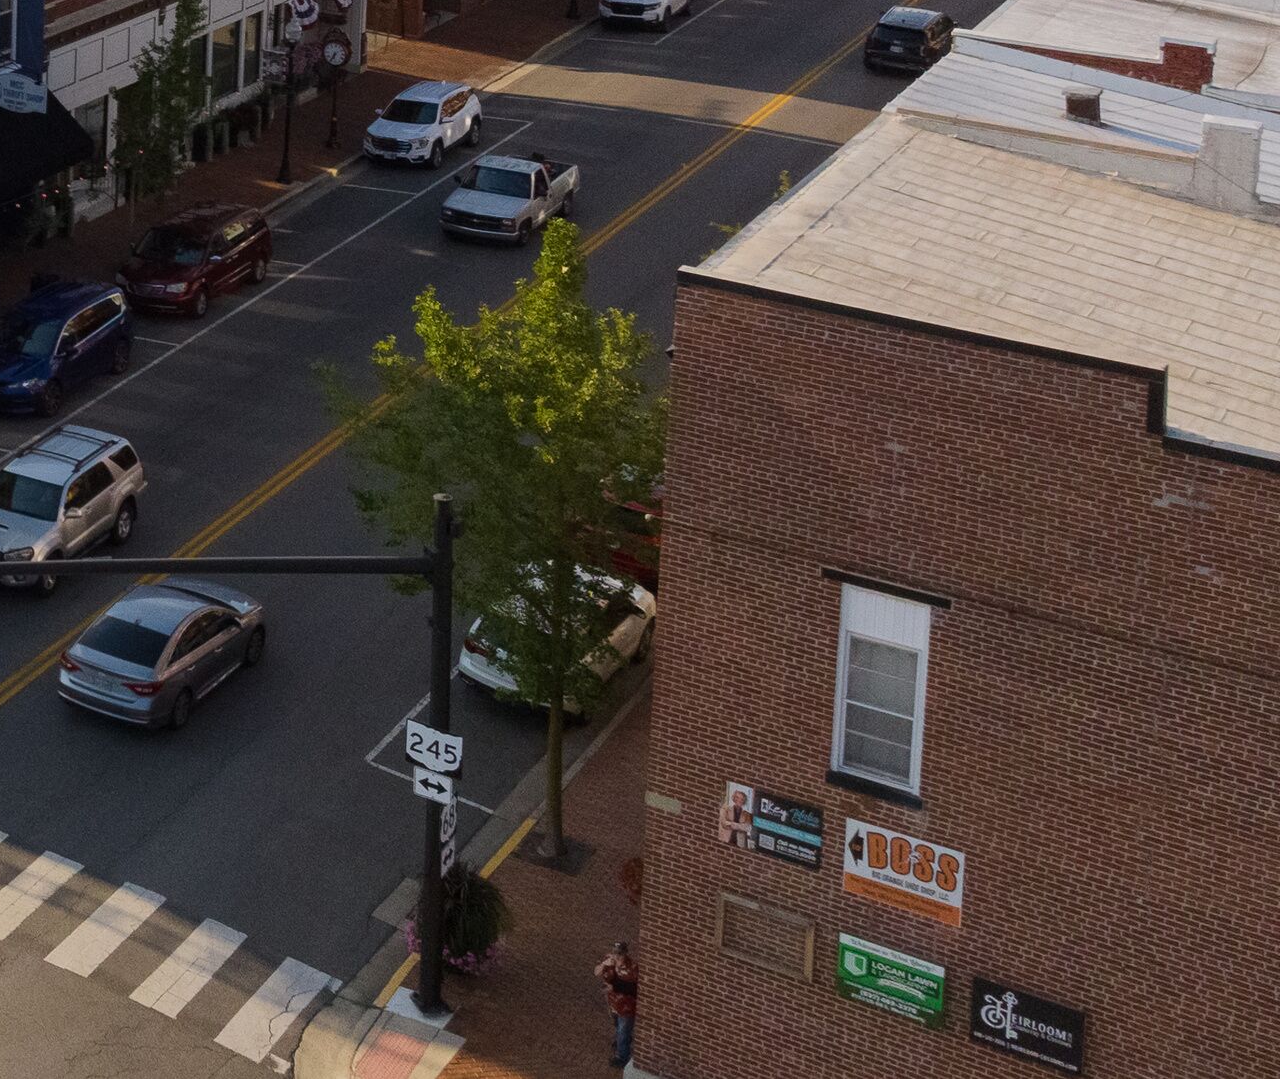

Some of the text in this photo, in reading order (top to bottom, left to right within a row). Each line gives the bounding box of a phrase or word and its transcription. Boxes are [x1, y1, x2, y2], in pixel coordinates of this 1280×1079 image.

[410, 732, 457, 764] 245
[866, 831, 960, 892] BOSS
[871, 961, 906, 979] LOGAN
[907, 973, 938, 990] LAWN
